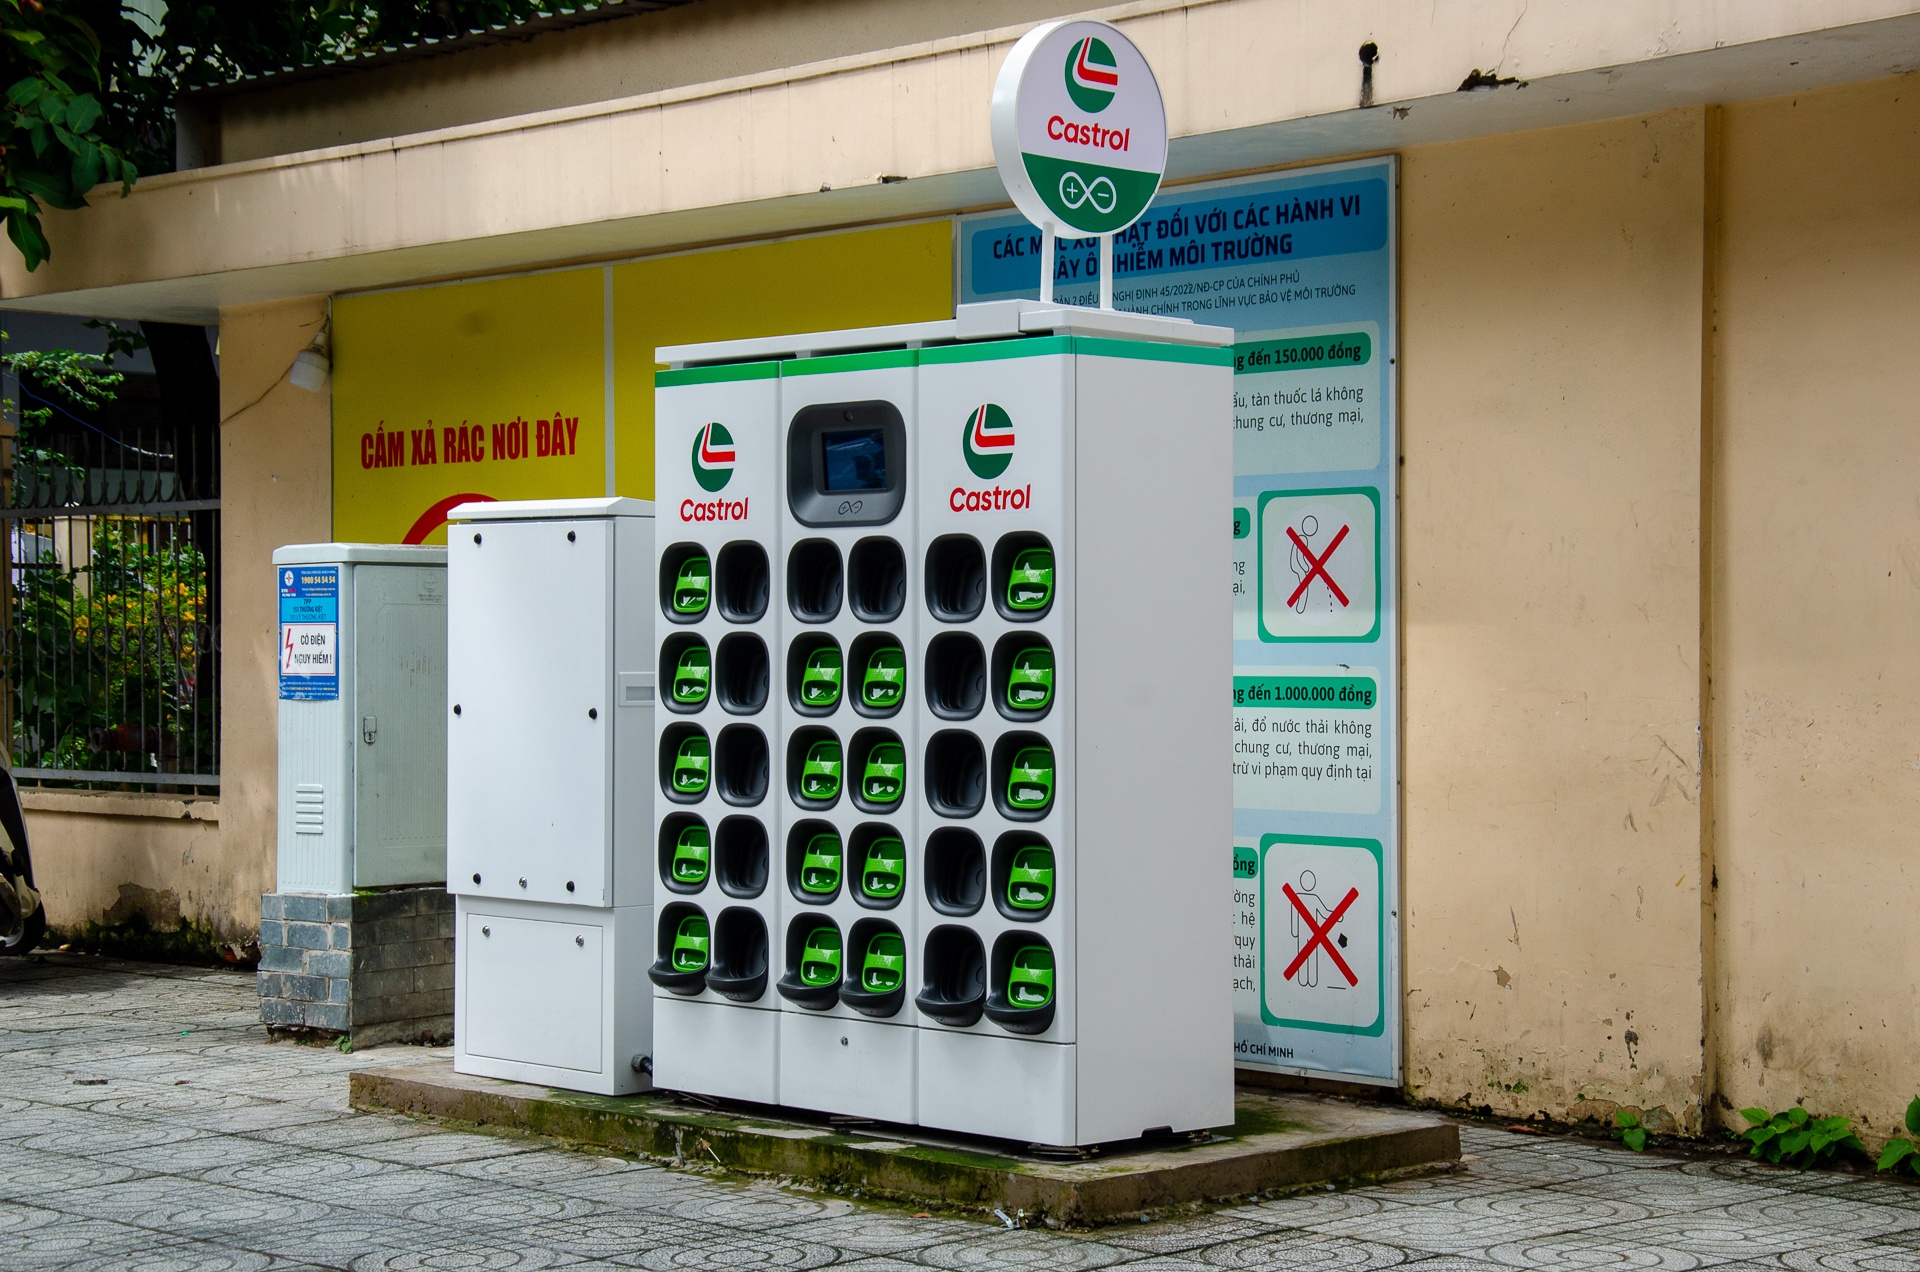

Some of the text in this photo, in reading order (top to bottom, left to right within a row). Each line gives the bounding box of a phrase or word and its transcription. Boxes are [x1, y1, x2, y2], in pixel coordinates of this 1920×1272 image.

[1047, 115, 1130, 152] Castrol
[993, 233, 1025, 259] CÁC
[1030, 234, 1068, 255] MC
[1113, 221, 1152, 248] HẠT
[1156, 207, 1189, 240] ĐỐI
[1194, 206, 1227, 235] VỚI
[1233, 202, 1270, 230] CÁC
[1276, 197, 1334, 225] HÀNH
[1339, 194, 1361, 217] VI
[1053, 232, 1293, 280] ÂY Ô HIỄM MÔI TRƯỜNG
[1112, 288, 1134, 302] NGHỊ
[1135, 287, 1158, 301] ĐỊNH
[1226, 275, 1246, 290] CỦA
[1247, 272, 1278, 288] CHÍNH
[1280, 269, 1300, 285] PHỦ
[1151, 301, 1179, 315] CHÍNH
[1182, 298, 1213, 312] TRONG
[1214, 295, 1236, 309] LĨNH
[1237, 293, 1257, 308] VỰC
[1259, 289, 1278, 305] BẢO
[1280, 288, 1292, 304] VỆ
[1294, 286, 1313, 301] MÔI
[1315, 283, 1356, 299] TRƯỜNG
[1247, 347, 1271, 367] đến
[1274, 347, 1324, 365] 150.000
[1327, 341, 1362, 362] đồng
[1251, 392, 1270, 407] tàn
[1274, 387, 1307, 406] thuốc
[1311, 387, 1322, 403] lá
[1326, 385, 1364, 403] không
[1269, 413, 1286, 428] cư,
[1290, 411, 1333, 427] thương
[1338, 407, 1364, 425] mại,
[361, 411, 579, 470] CẤM XẢ RÁC NƠI ĐÂY
[949, 483, 1031, 513] Castrol
[680, 496, 749, 522] Castrol
[301, 576, 336, 585] 1900 54 54 54
[1232, 579, 1246, 597] ại,
[300, 632, 326, 647] CÓ ĐIỆN
[294, 653, 311, 664] NGUY
[312, 650, 329, 664] HIỂM
[1248, 683, 1271, 701] đến
[1274, 686, 1335, 702] 1.000.000
[1338, 684, 1373, 706] đồng
[1234, 715, 1372, 738] ải, đổ nước thải không
[1234, 739, 1372, 760] chung cư, thương mại,
[1233, 761, 1372, 782] trừ vi phạm quy định tại
[1233, 853, 1256, 876] ồng
[1233, 888, 1256, 908] ờng
[1241, 910, 1256, 929] hệ
[1234, 935, 1256, 951] quy
[1233, 953, 1256, 969] thải
[1233, 975, 1256, 993] ạch,
[1249, 1042, 1267, 1056] CHÍ
[1268, 1045, 1294, 1059] MINH
